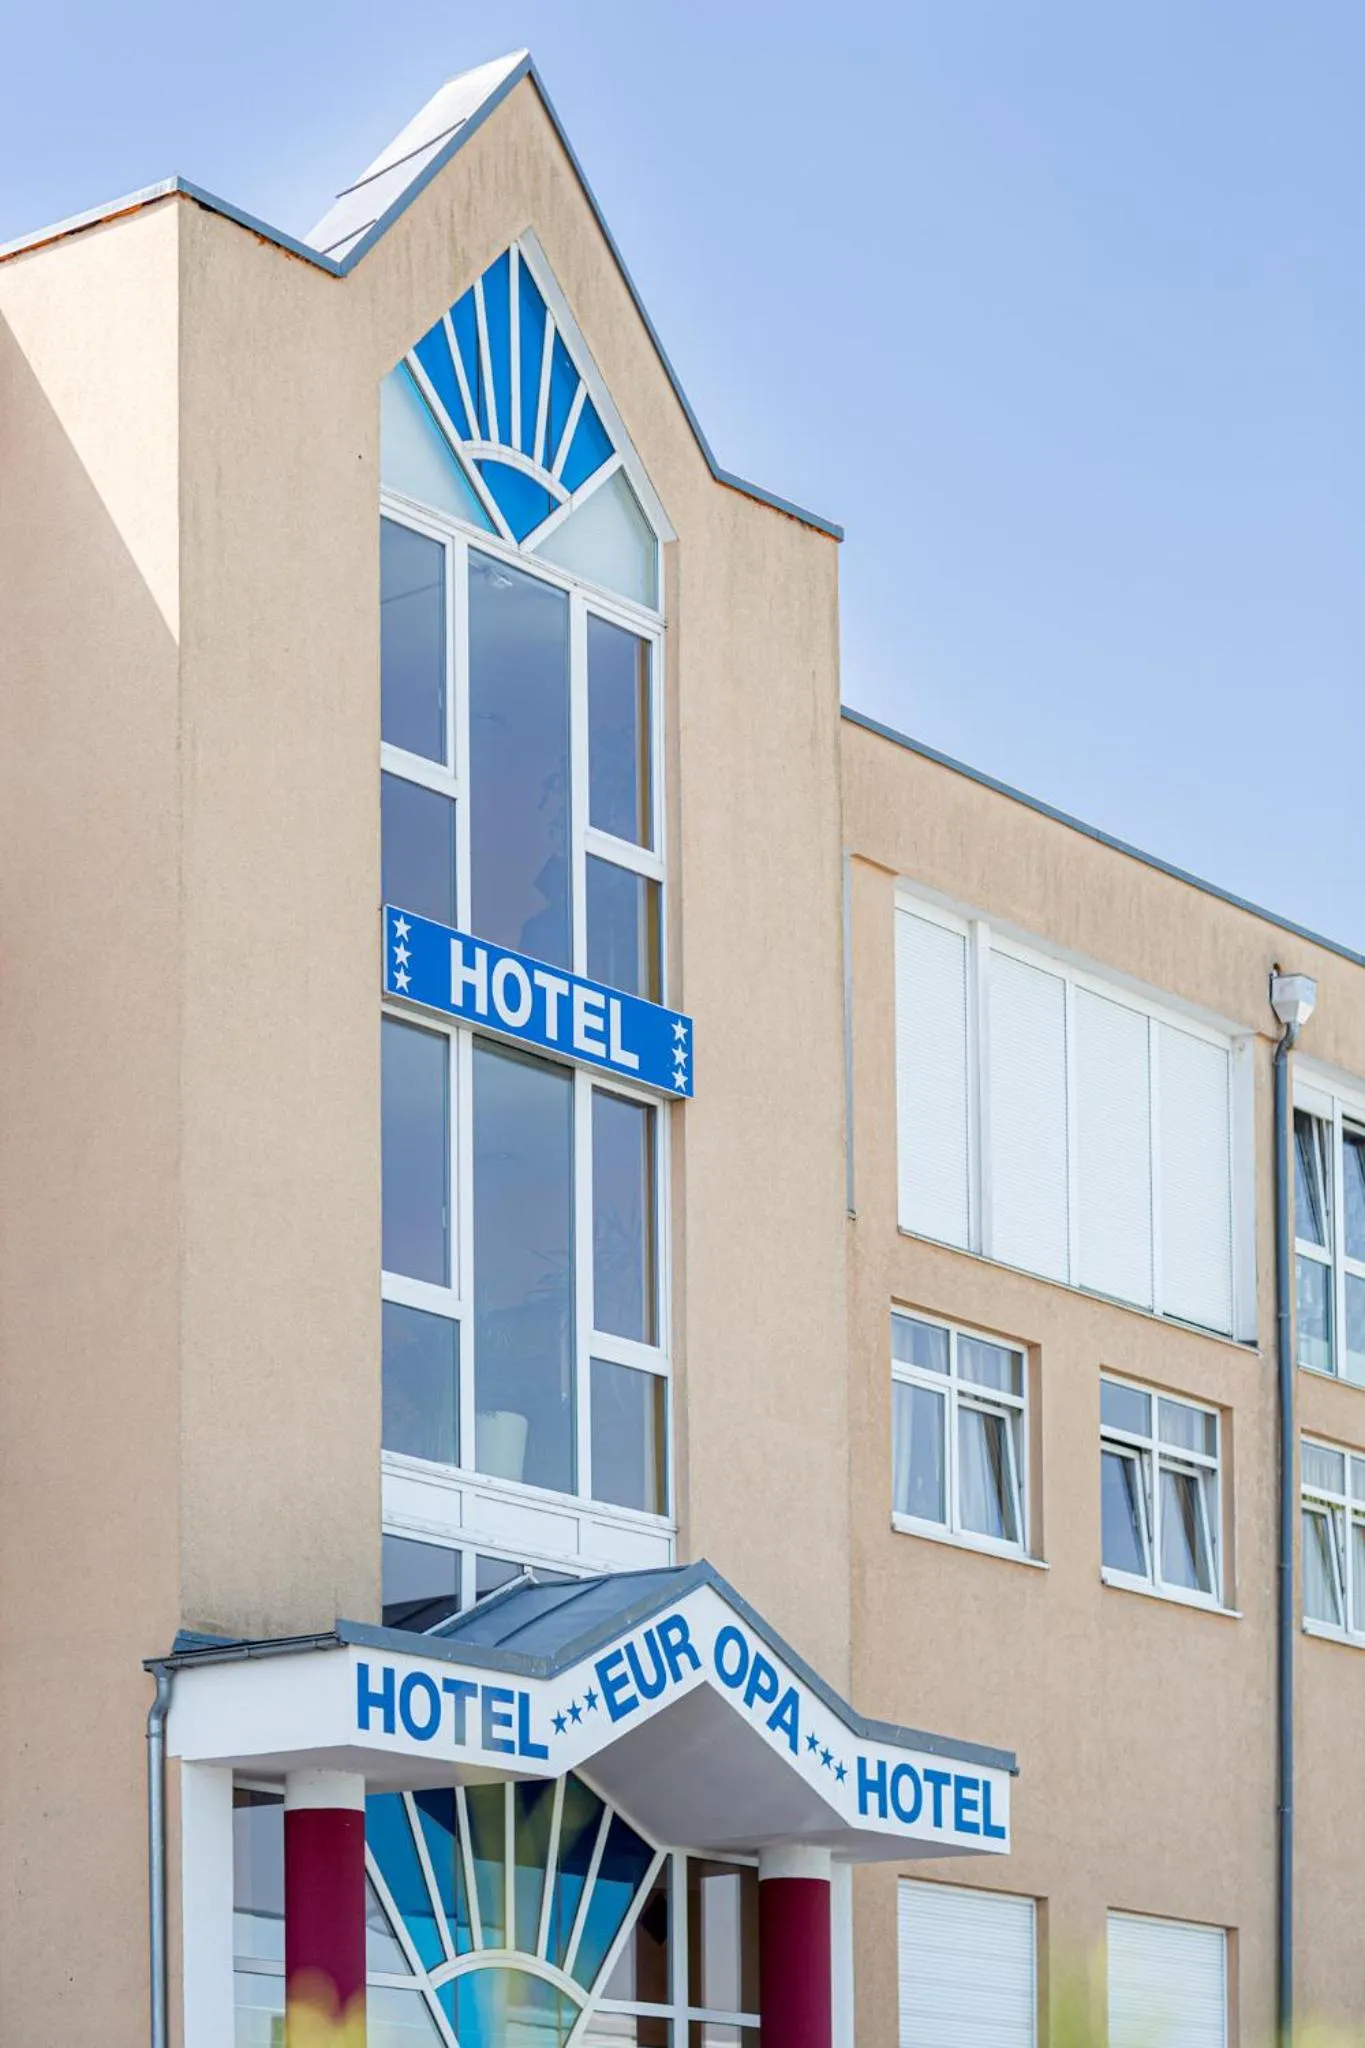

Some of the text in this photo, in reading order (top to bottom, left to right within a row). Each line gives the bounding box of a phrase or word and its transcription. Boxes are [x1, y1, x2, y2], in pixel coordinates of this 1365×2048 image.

[450, 938, 640, 1070] HOTEL
[356, 1662, 549, 1760] HOTEL
[856, 1756, 1007, 1840] HOTEL
